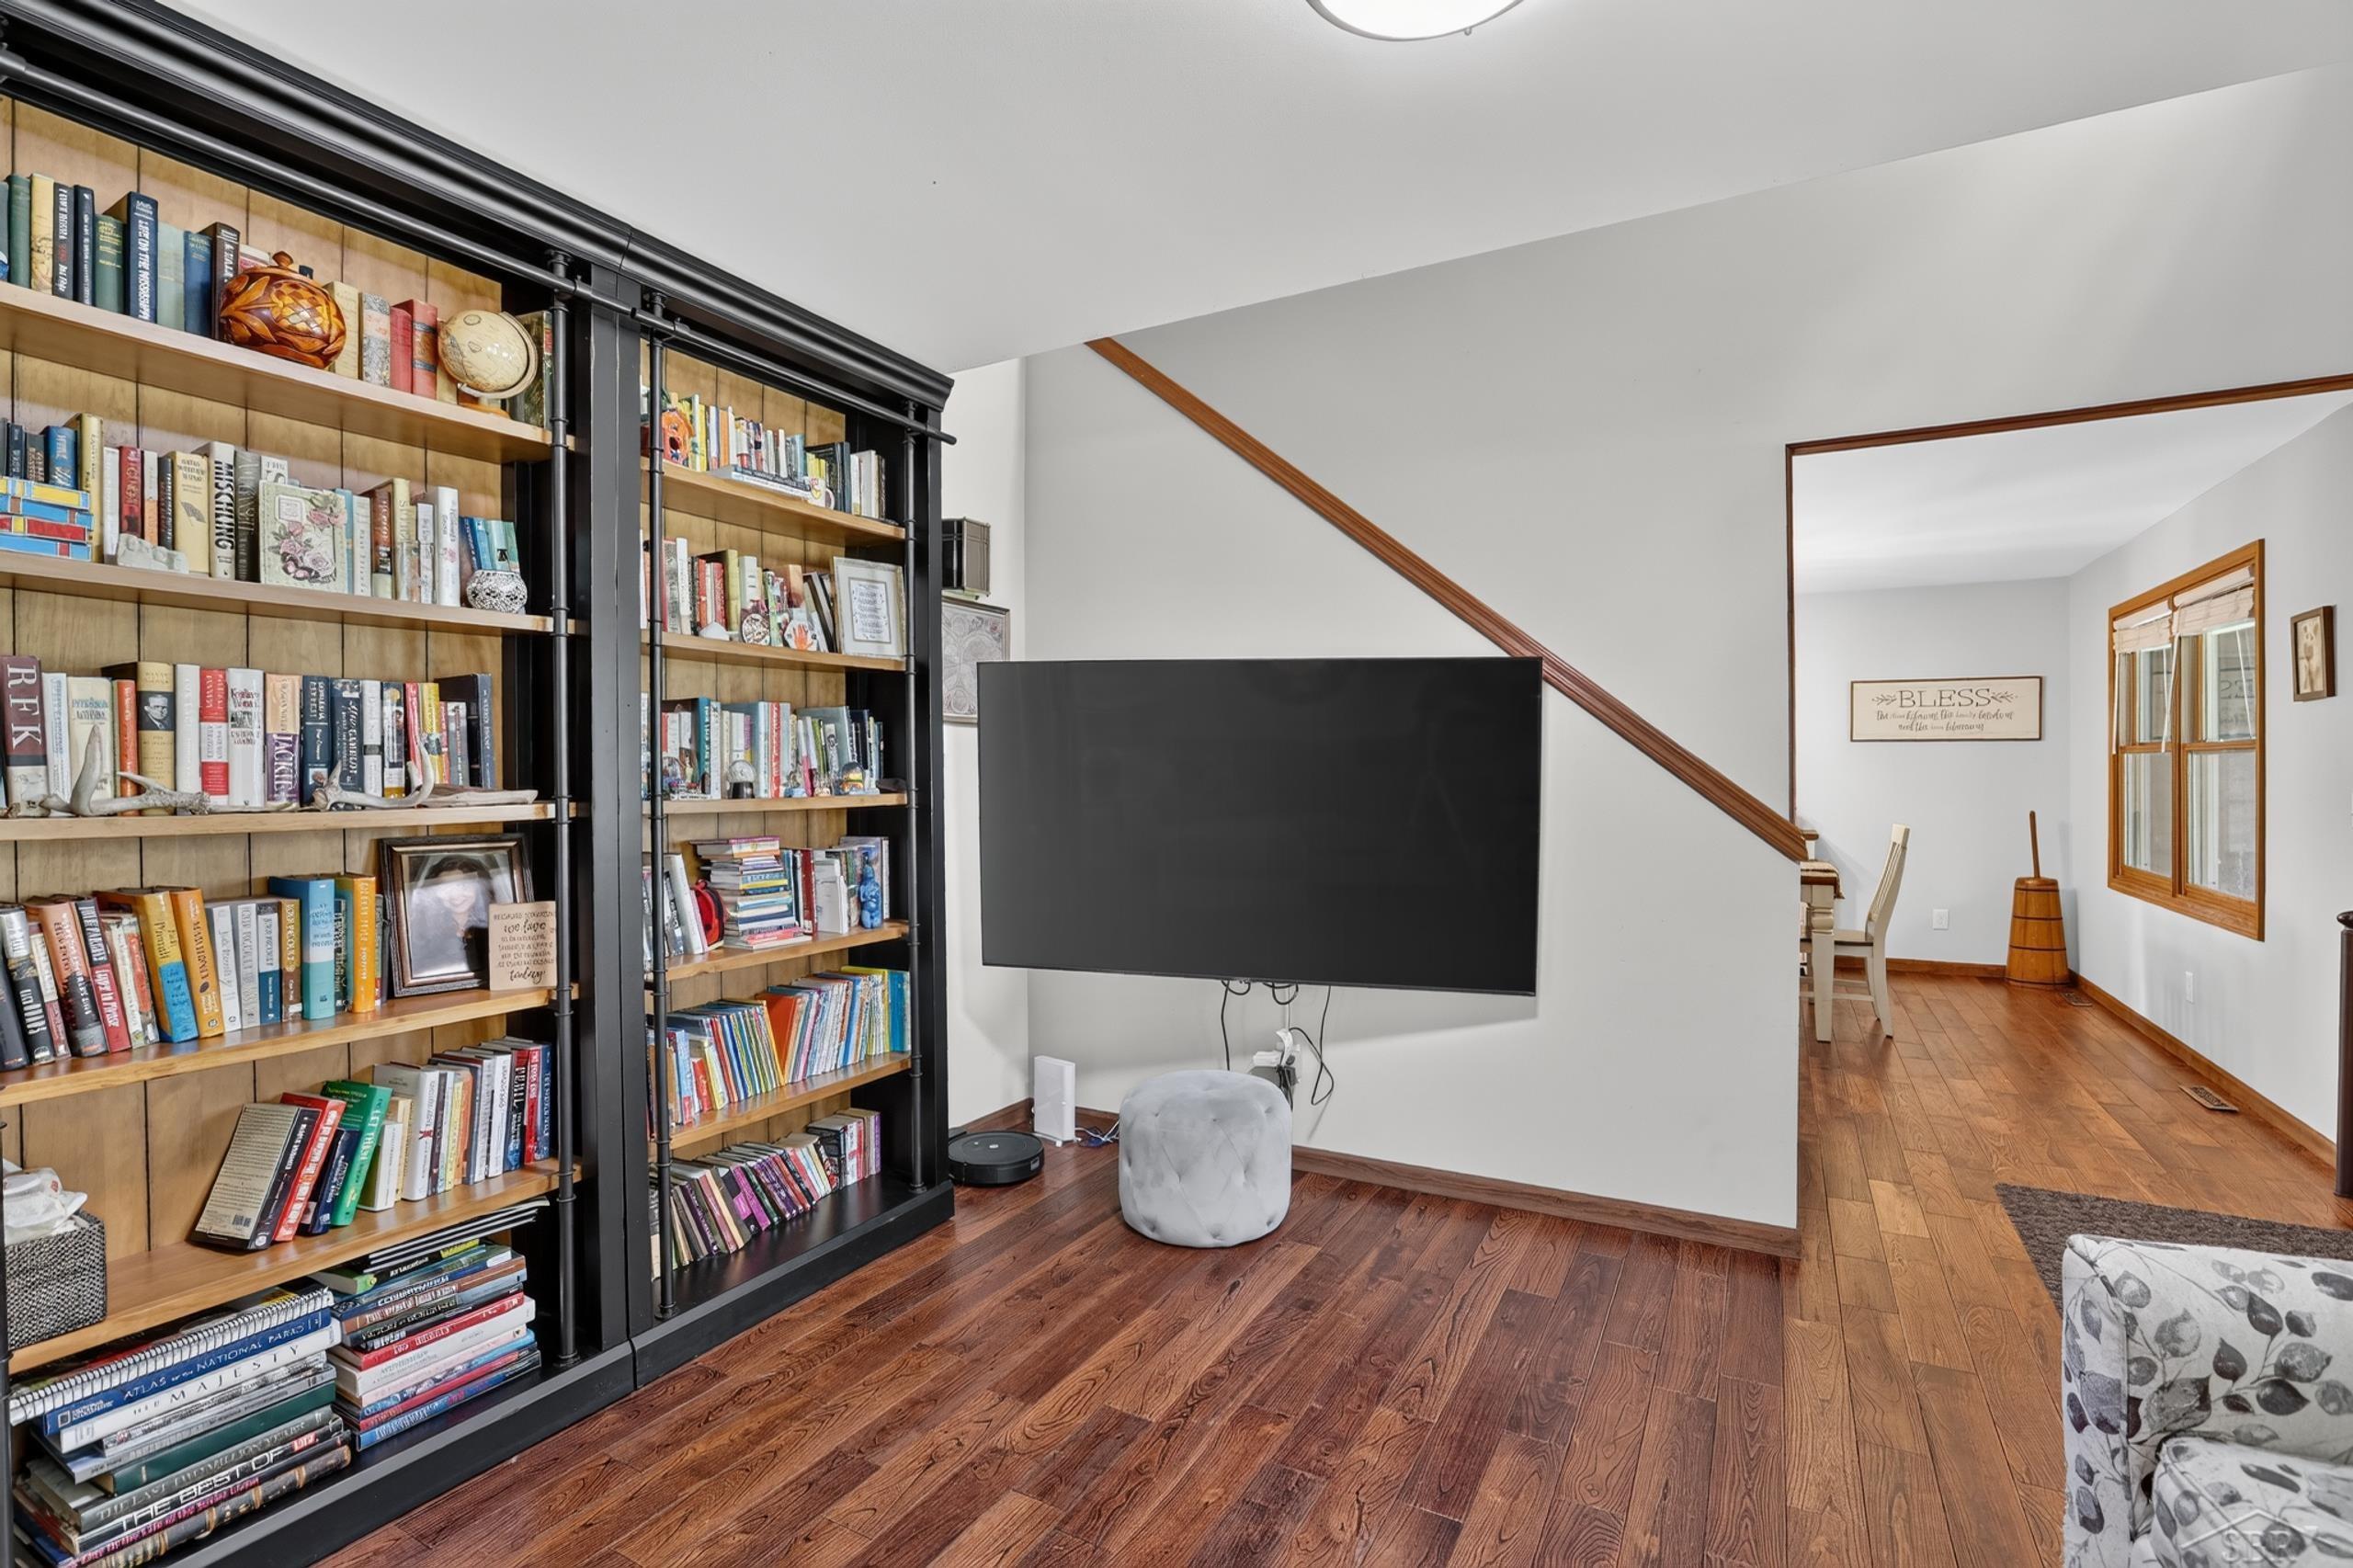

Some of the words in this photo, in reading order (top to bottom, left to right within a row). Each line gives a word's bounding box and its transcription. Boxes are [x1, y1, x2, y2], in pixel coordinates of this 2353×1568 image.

[214, 460, 234, 551] MISCHLING
[6, 664, 42, 750] RFK
[1897, 687, 1992, 709] BLESS
[273, 733, 295, 791] JACKIE
[123, 1376, 166, 1401] ATLAS
[196, 1342, 263, 1371] NATIONAL
[169, 1345, 299, 1403] MAJESTY
[111, 1501, 172, 1532] THE
[179, 1466, 244, 1505] BEST
[251, 1446, 287, 1471] OF
